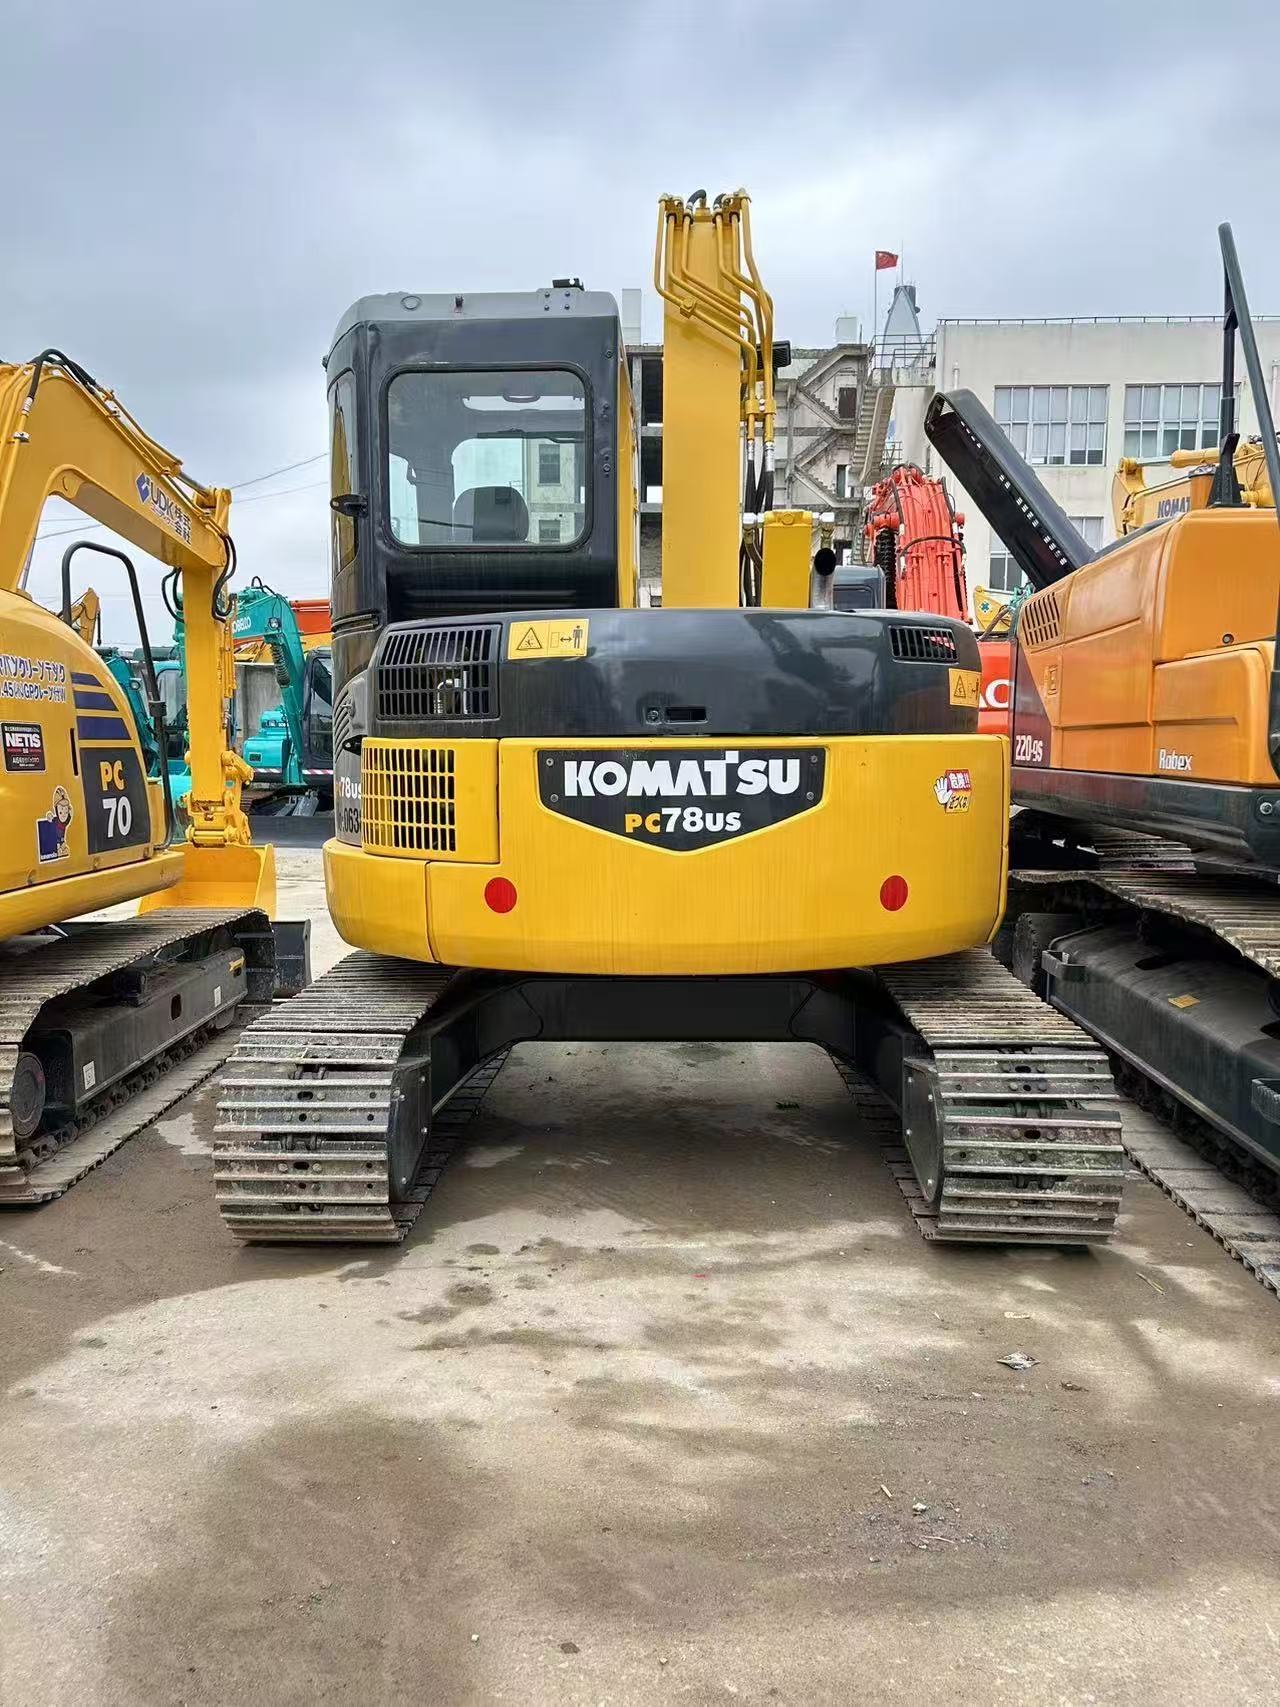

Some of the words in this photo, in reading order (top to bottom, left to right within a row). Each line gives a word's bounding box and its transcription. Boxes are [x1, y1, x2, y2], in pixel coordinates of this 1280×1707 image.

[5, 732, 41, 748] NETIS
[564, 750, 801, 797] KOMATSU
[1159, 748, 1193, 771] Robex
[100, 760, 125, 791] PC
[102, 796, 132, 838] 70
